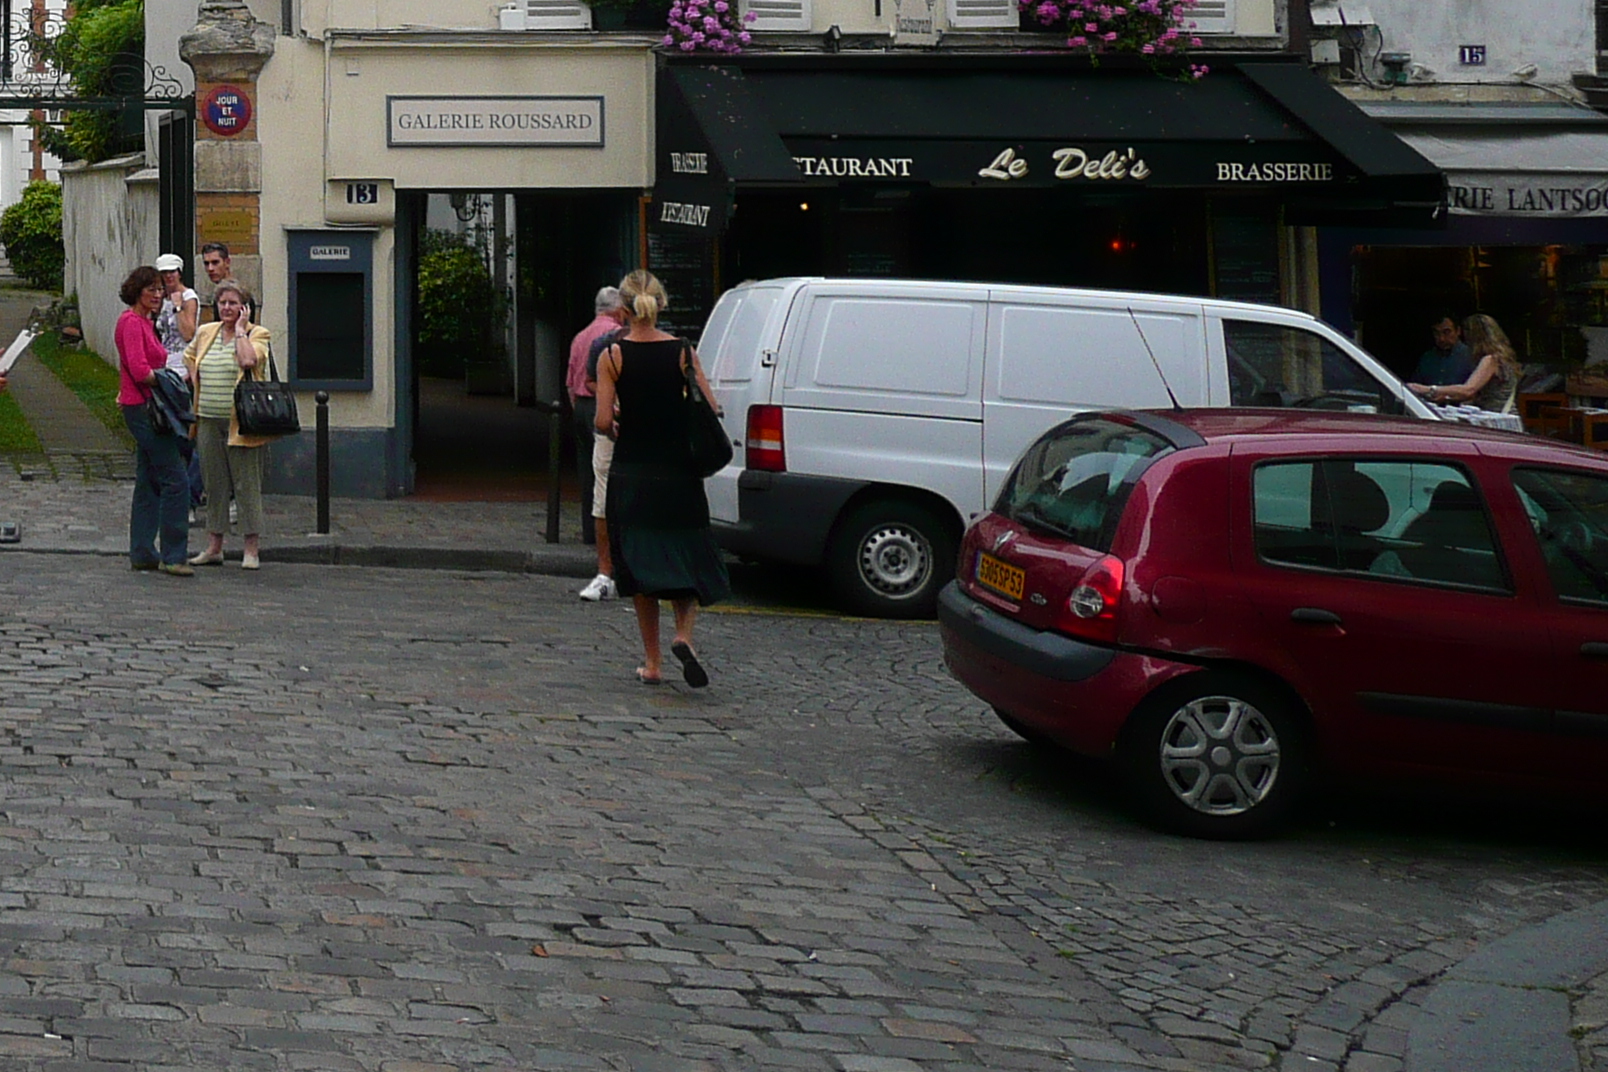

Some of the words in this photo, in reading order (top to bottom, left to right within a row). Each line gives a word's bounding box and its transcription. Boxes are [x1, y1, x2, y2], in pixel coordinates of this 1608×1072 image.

[1464, 48, 1483, 63] 15
[216, 96, 238, 105] JOUR
[222, 107, 232, 115] ET
[218, 117, 236, 126] NUIT
[398, 113, 484, 129] GALERIE
[490, 114, 592, 129] ROUSSARD
[978, 147, 1029, 180] Le
[1052, 147, 1152, 180] Deli's
[1216, 162, 1333, 181] BRASSERIE
[352, 183, 372, 203] 13
